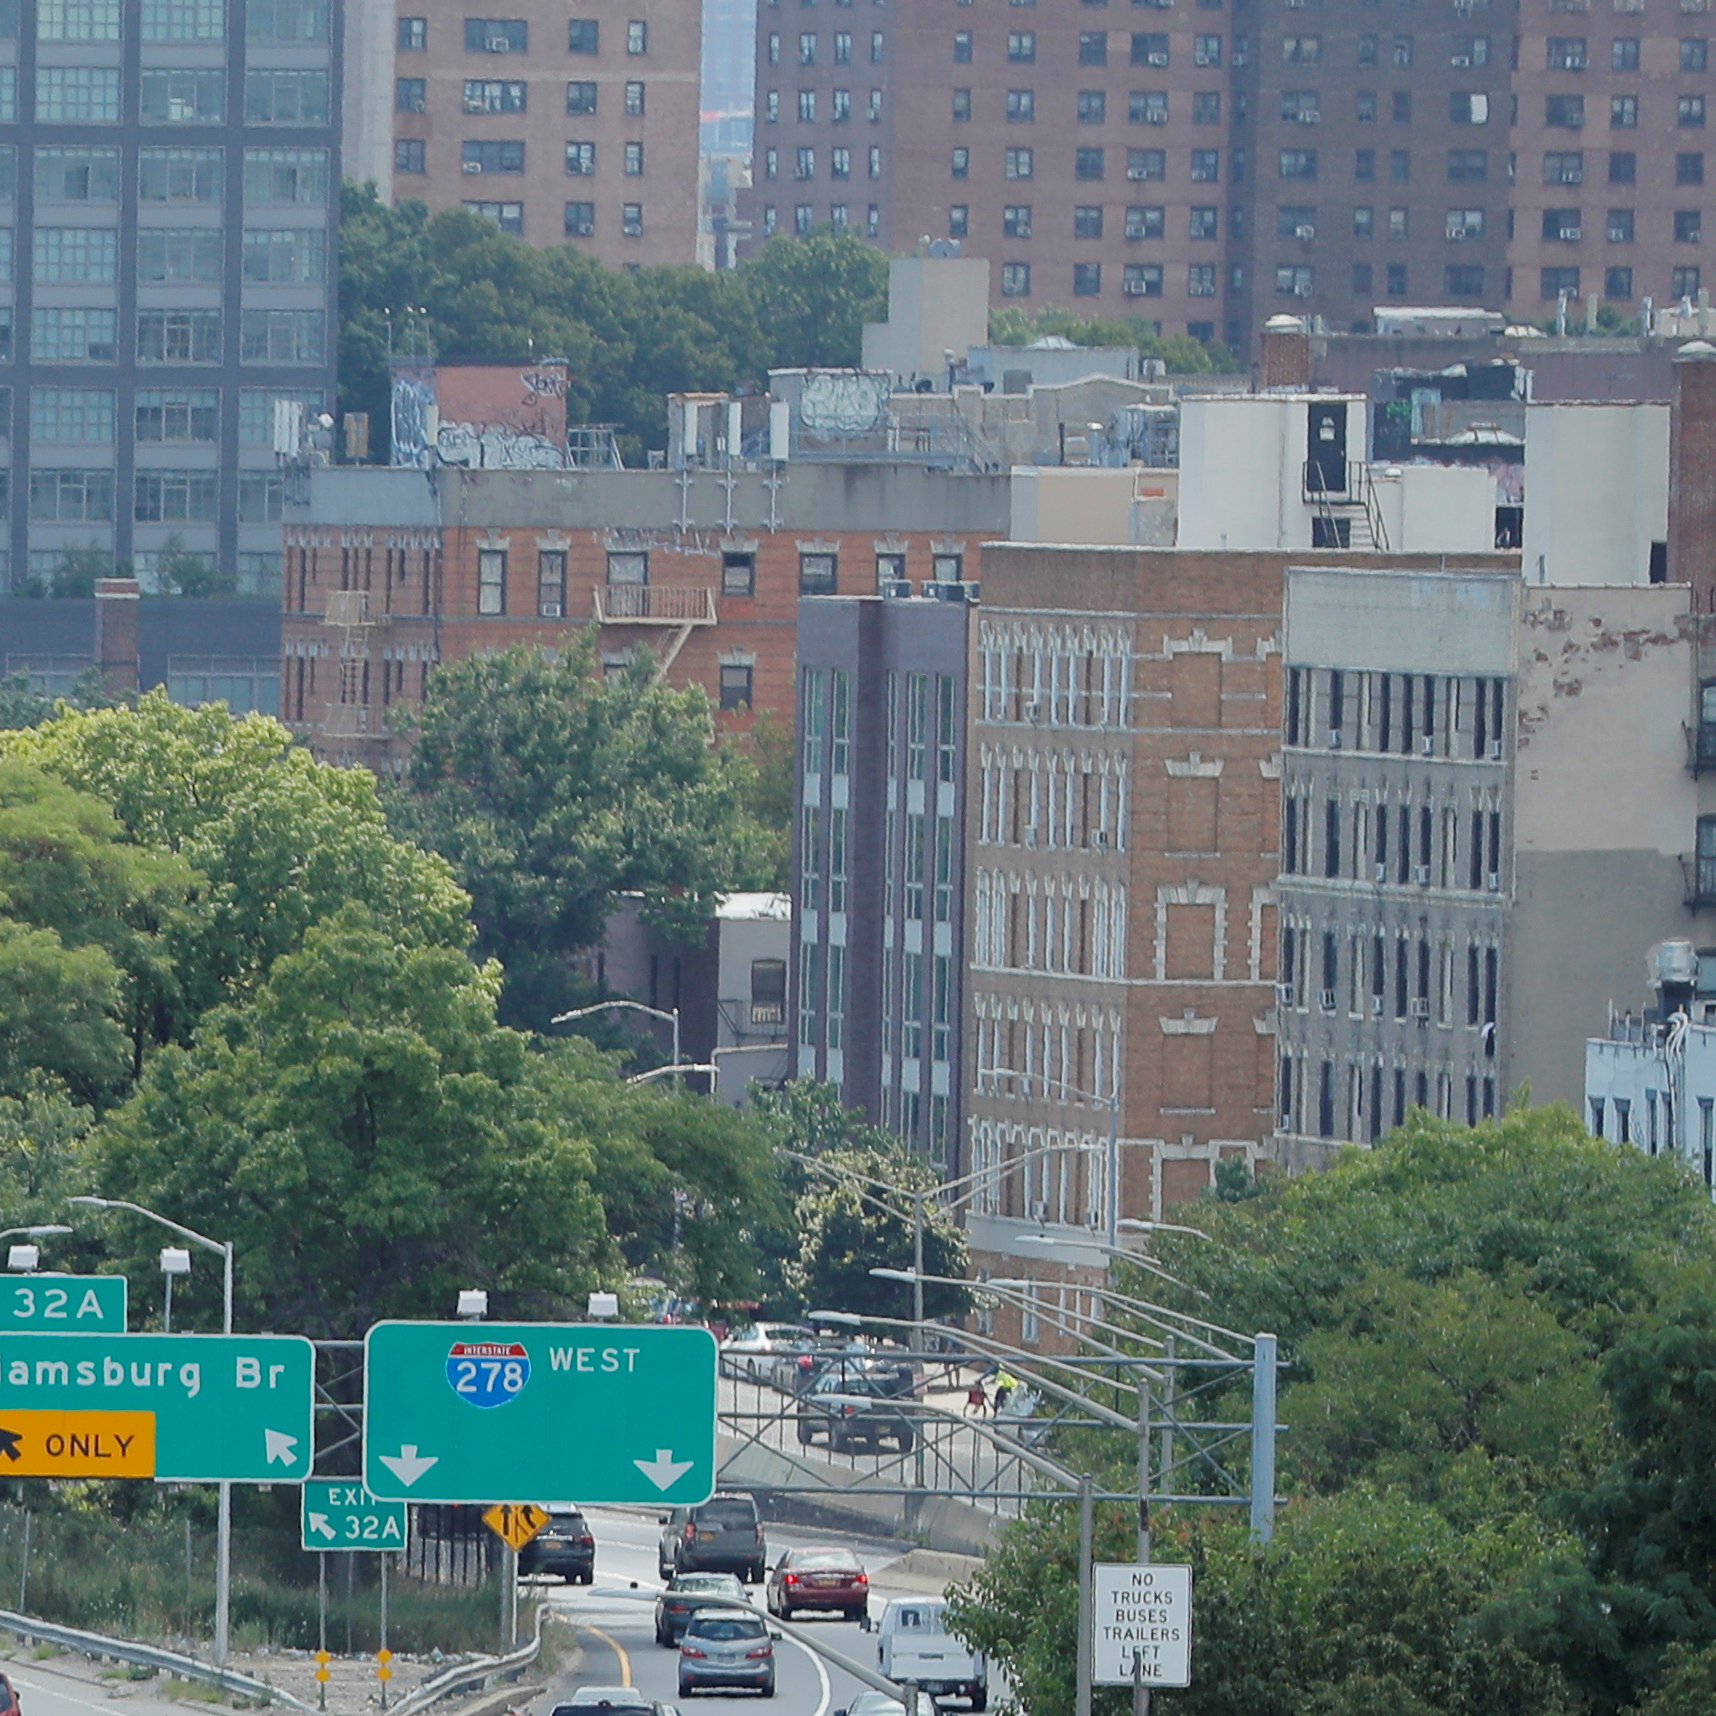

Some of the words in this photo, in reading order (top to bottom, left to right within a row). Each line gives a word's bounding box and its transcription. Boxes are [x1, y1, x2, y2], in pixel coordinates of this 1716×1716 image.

[13, 1288, 104, 1319] 32A
[463, 1345, 512, 1356] INTERSTATE
[549, 1347, 640, 1373] WEST
[235, 1356, 285, 1389] Br
[456, 1361, 524, 1393] 278
[45, 1433, 135, 1459] ONLY
[345, 1515, 401, 1540] 32A
[1131, 1572, 1154, 1587] NO
[1111, 1590, 1173, 1605] TRUCKS
[1116, 1608, 1168, 1623] BUSES
[1103, 1626, 1180, 1641] TRAILERS
